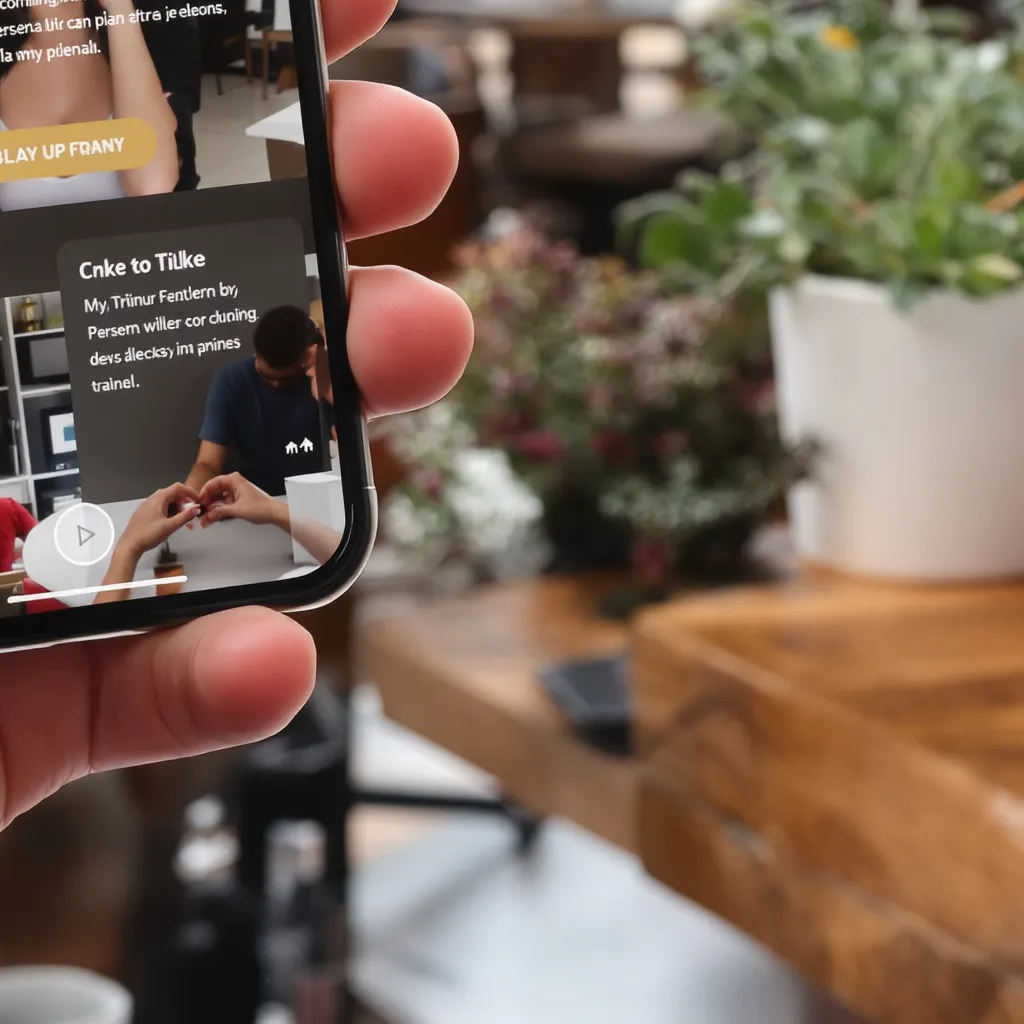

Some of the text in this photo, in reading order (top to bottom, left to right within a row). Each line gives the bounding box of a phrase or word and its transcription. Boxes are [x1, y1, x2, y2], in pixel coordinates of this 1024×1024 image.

[67, 17, 92, 30] can
[0, 47, 13, 63] la
[42, 144, 66, 160] UP
[79, 259, 127, 280] Cnke
[130, 257, 152, 275] to
[184, 315, 207, 328] cor
